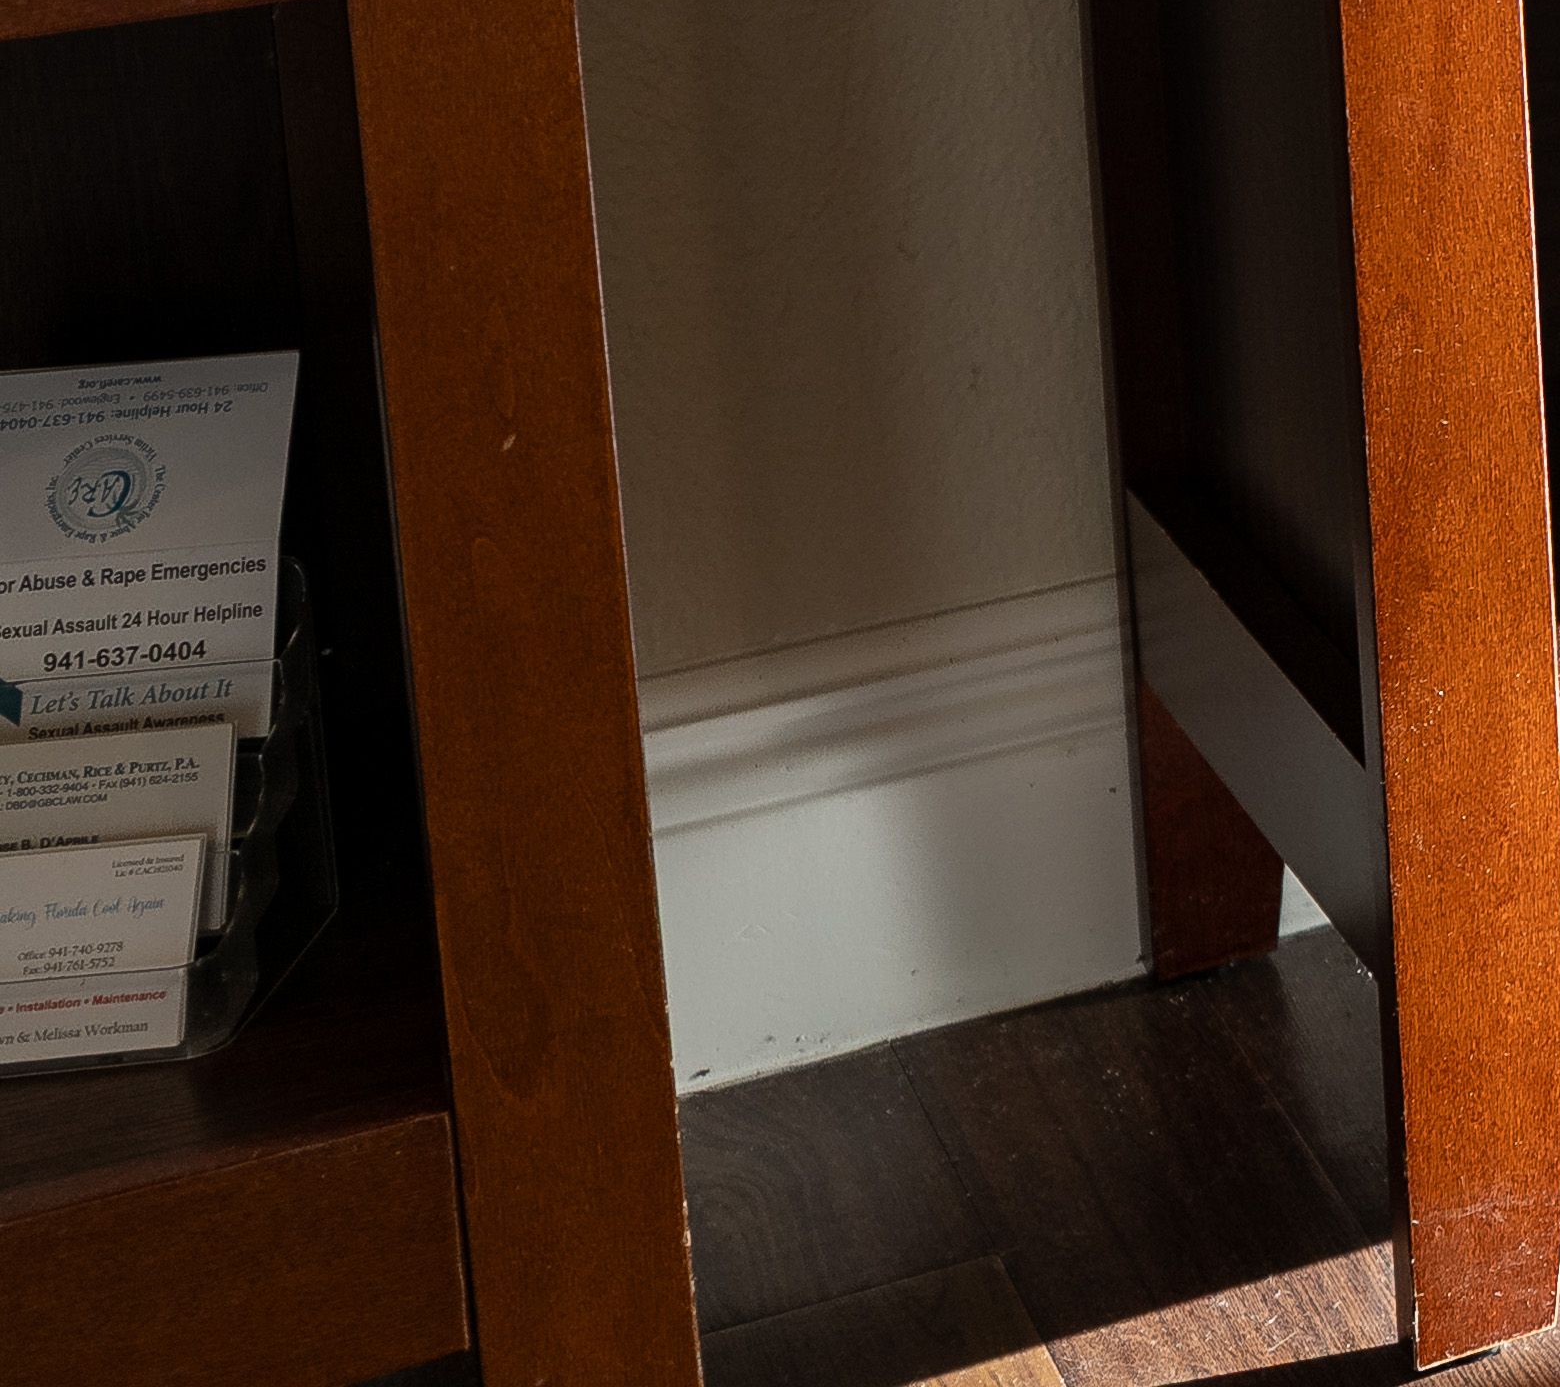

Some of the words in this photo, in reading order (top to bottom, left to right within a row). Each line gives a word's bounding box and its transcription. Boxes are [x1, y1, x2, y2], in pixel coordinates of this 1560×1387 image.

[143, 384, 229, 403] 941-639-5499
[111, 402, 171, 419] Helpline:
[175, 402, 209, 415] Hour
[214, 400, 233, 414] 24
[0, 411, 105, 432] 941-637-0404
[94, 433, 134, 447] Services
[18, 573, 77, 594] Abuse
[81, 570, 95, 587] &
[101, 567, 146, 587] Rape
[151, 556, 267, 581] Emergencies
[0, 620, 48, 640] exual
[51, 614, 117, 636] Assault
[122, 611, 142, 629] 24
[147, 607, 189, 627] Hour
[193, 602, 263, 623] Helpline
[43, 639, 207, 673] 941-637-0404
[30, 690, 80, 716] Let's
[87, 685, 136, 710] Talk
[140, 681, 210, 706] About
[214, 677, 235, 699] It
[28, 723, 79, 741] Sexual
[83, 717, 141, 736] Assault
[145, 711, 226, 730] Awareness
[114, 762, 125, 776] &
[175, 757, 200, 770] P.A.
[120, 775, 146, 789] (941)
[149, 772, 199, 786] 624-2155
[45, 902, 88, 921] Florida
[48, 941, 124, 959] 941-740-9278
[43, 957, 115, 974] 941-761-5752
[16, 998, 81, 1014] Installation
[92, 990, 168, 1006] Maintenance
[33, 1026, 81, 1043] Melissa
[85, 1021, 149, 1038] Workman
